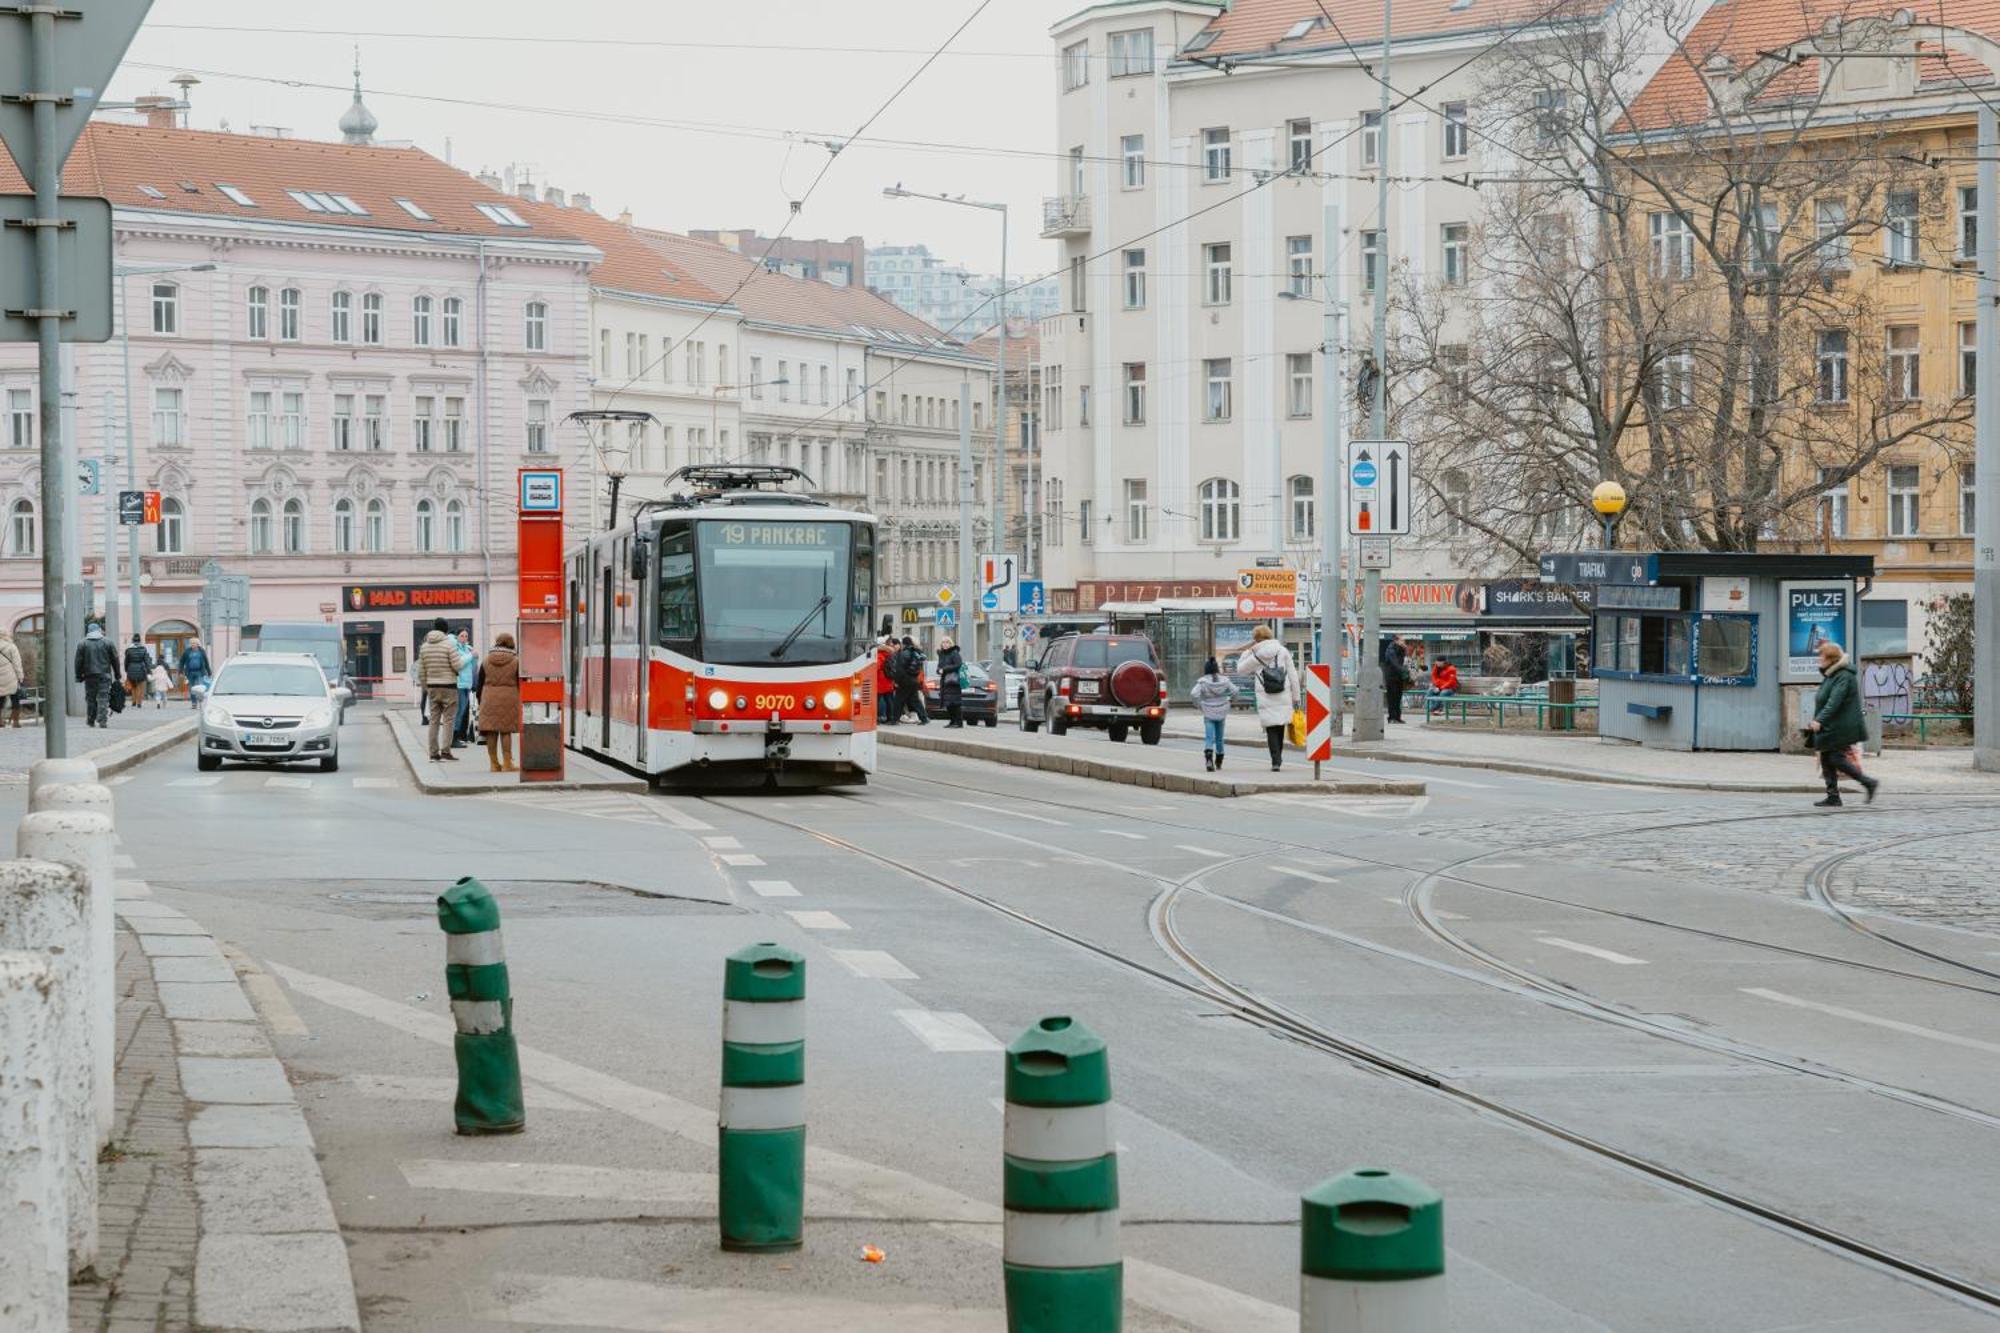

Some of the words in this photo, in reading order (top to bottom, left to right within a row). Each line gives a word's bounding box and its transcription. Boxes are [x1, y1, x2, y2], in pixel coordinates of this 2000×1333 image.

[720, 524, 745, 544] 19
[1578, 561, 1606, 577] TRAFIKA
[369, 589, 407, 607] MAD
[409, 588, 476, 606] RUNNER
[1106, 585, 1235, 603] PIZZERIA
[1496, 590, 1545, 603] SHARK'S
[1792, 593, 1843, 607] PULZE
[755, 694, 795, 710] 9070
